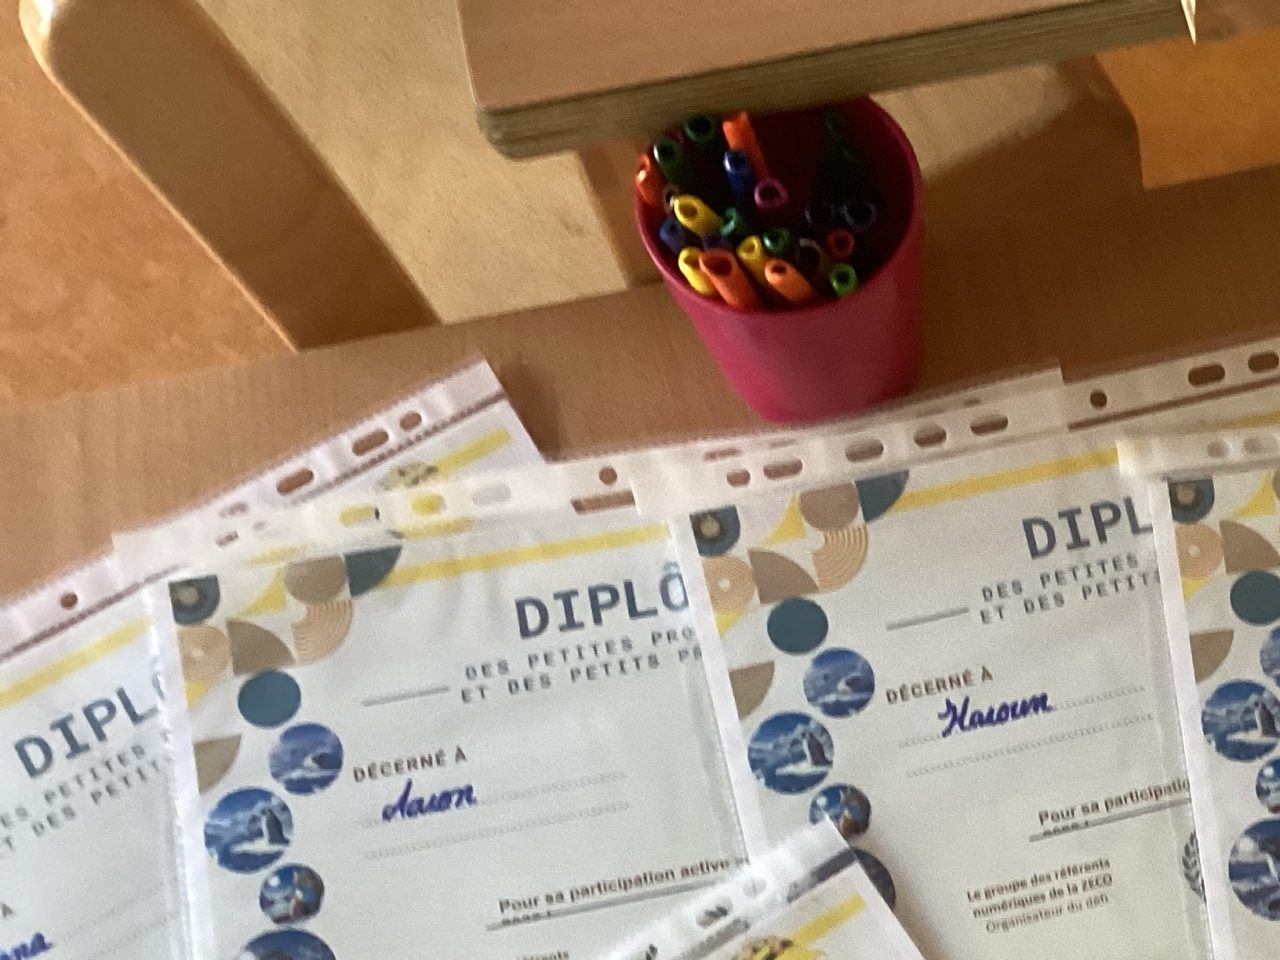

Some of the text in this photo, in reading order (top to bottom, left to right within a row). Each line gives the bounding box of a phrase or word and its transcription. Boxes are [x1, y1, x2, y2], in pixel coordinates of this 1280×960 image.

[1022, 496, 1154, 560] DIPL
[982, 553, 1139, 602] DES PETITES
[980, 605, 1005, 624] ET
[1024, 592, 1065, 614] DES
[461, 653, 660, 703] ET DES PETITS
[465, 636, 634, 681] DES PETITES
[885, 668, 975, 705] DÉCERNÉ
[14, 673, 165, 779] DIPL
[44, 744, 146, 805] PETITES
[90, 758, 160, 805] PETIT
[353, 750, 447, 783] DÉCERNÉ
[1038, 807, 1076, 826] Pour
[1081, 802, 1100, 816] sa
[499, 897, 538, 914] Pour
[545, 891, 565, 903] sa
[570, 867, 676, 904] participation
[681, 859, 731, 880] active
[967, 857, 1111, 903] Le groupe des référents
[973, 893, 1046, 918] numériques
[1049, 888, 1065, 901] de
[1067, 882, 1079, 894] la
